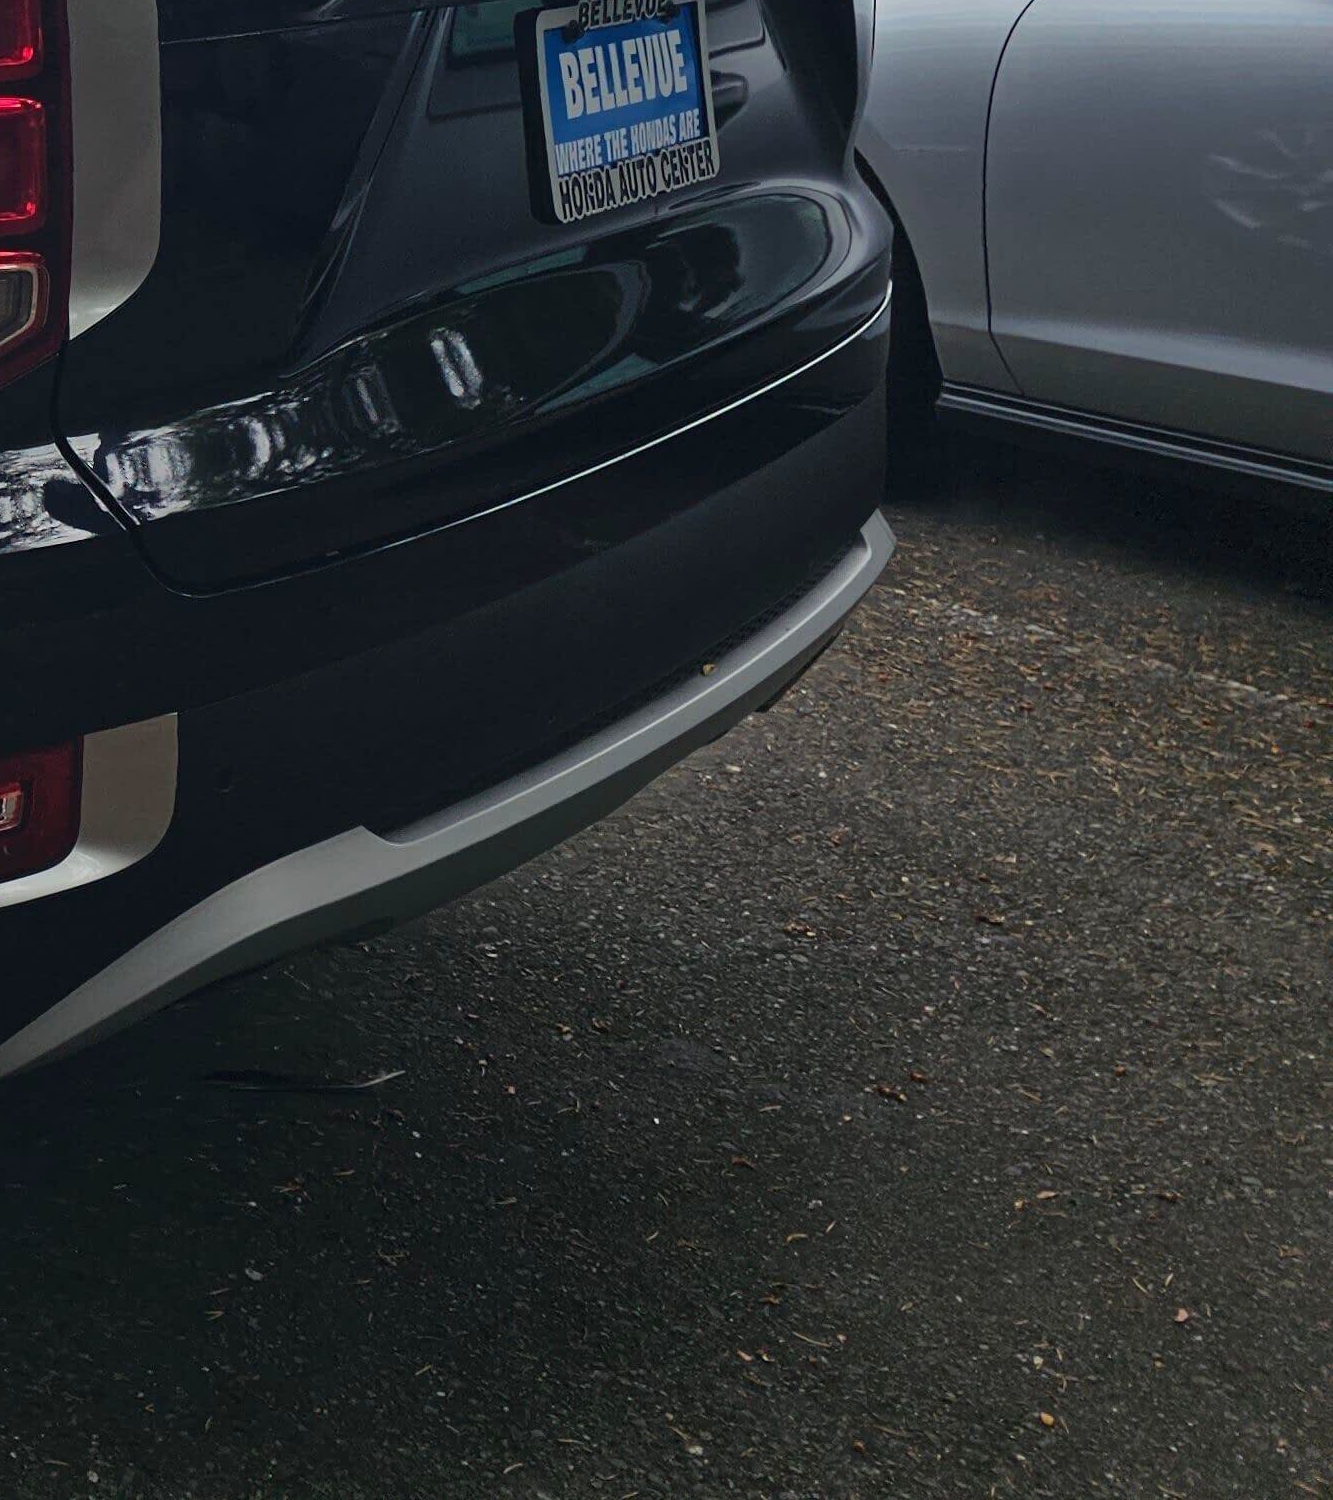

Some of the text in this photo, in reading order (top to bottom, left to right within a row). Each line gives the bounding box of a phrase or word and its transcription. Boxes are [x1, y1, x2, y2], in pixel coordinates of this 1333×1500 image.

[559, 29, 688, 119] BELLEVUE
[556, 107, 701, 175] WHERE THE HONDAS ARE
[559, 142, 715, 220] HONDA AUTO CENTER
